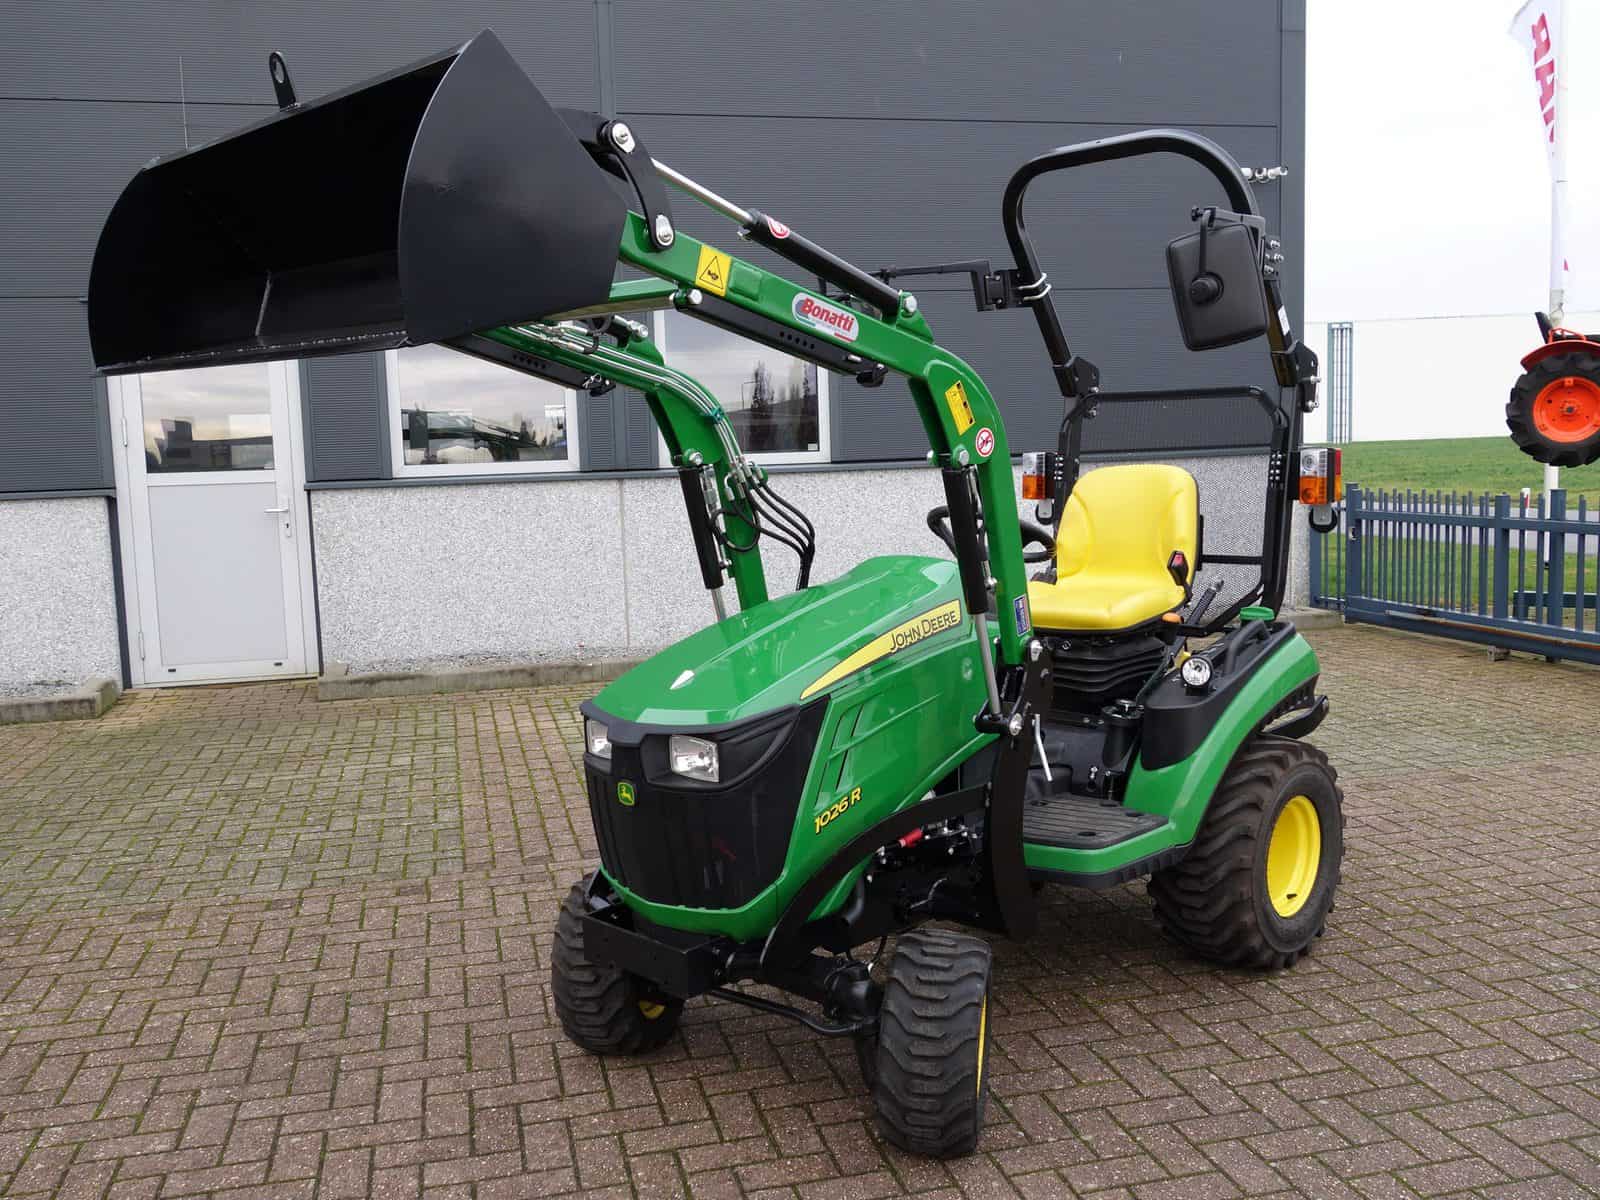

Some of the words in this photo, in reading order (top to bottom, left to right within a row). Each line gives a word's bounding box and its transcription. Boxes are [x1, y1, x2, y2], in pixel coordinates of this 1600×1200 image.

[801, 297, 855, 332] Bonatti
[890, 625, 921, 651] JOHN
[921, 610, 958, 635] DEERE
